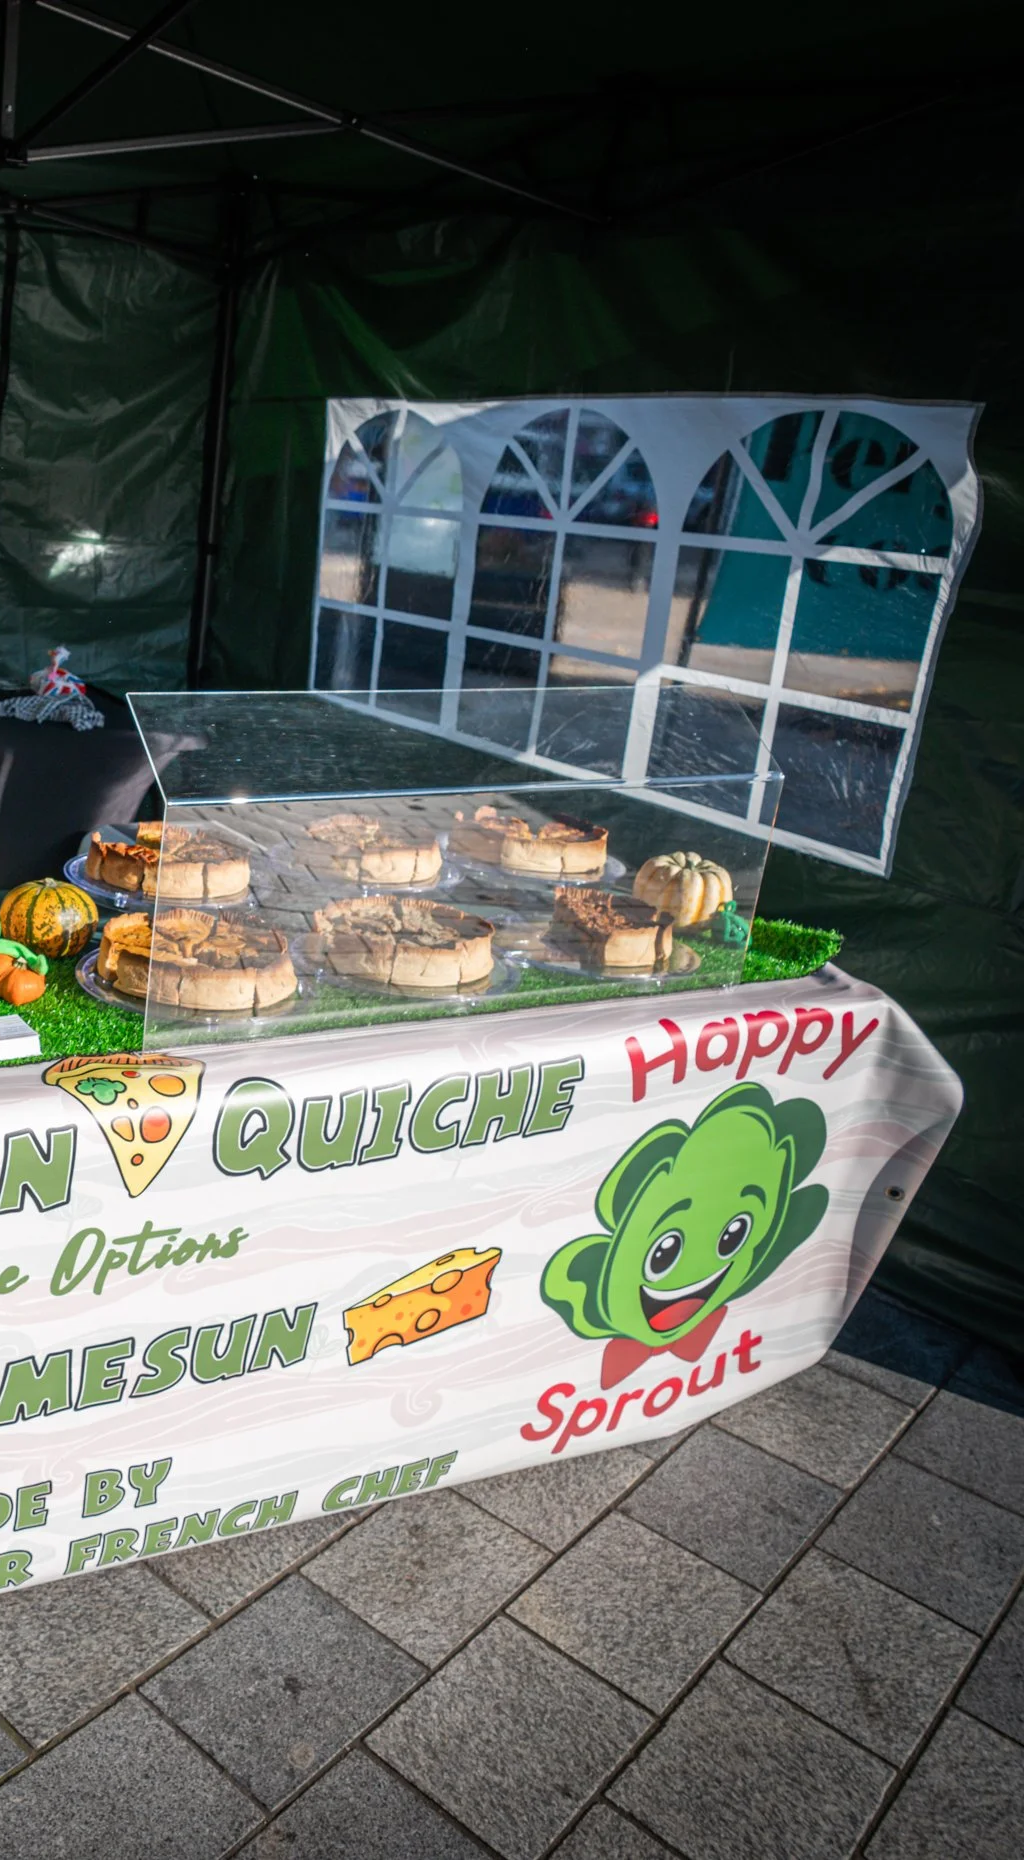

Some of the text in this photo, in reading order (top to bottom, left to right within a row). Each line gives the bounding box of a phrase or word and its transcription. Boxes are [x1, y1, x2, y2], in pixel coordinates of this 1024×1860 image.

[625, 1006, 880, 1103] Happy
[211, 1054, 585, 1180] QUICHE
[49, 1220, 249, 1297] Options
[520, 1328, 764, 1454] Sprout
[62, 1490, 299, 1576] FRENCH
[321, 1450, 459, 1513] CHEF
[81, 1456, 173, 1519] BY
